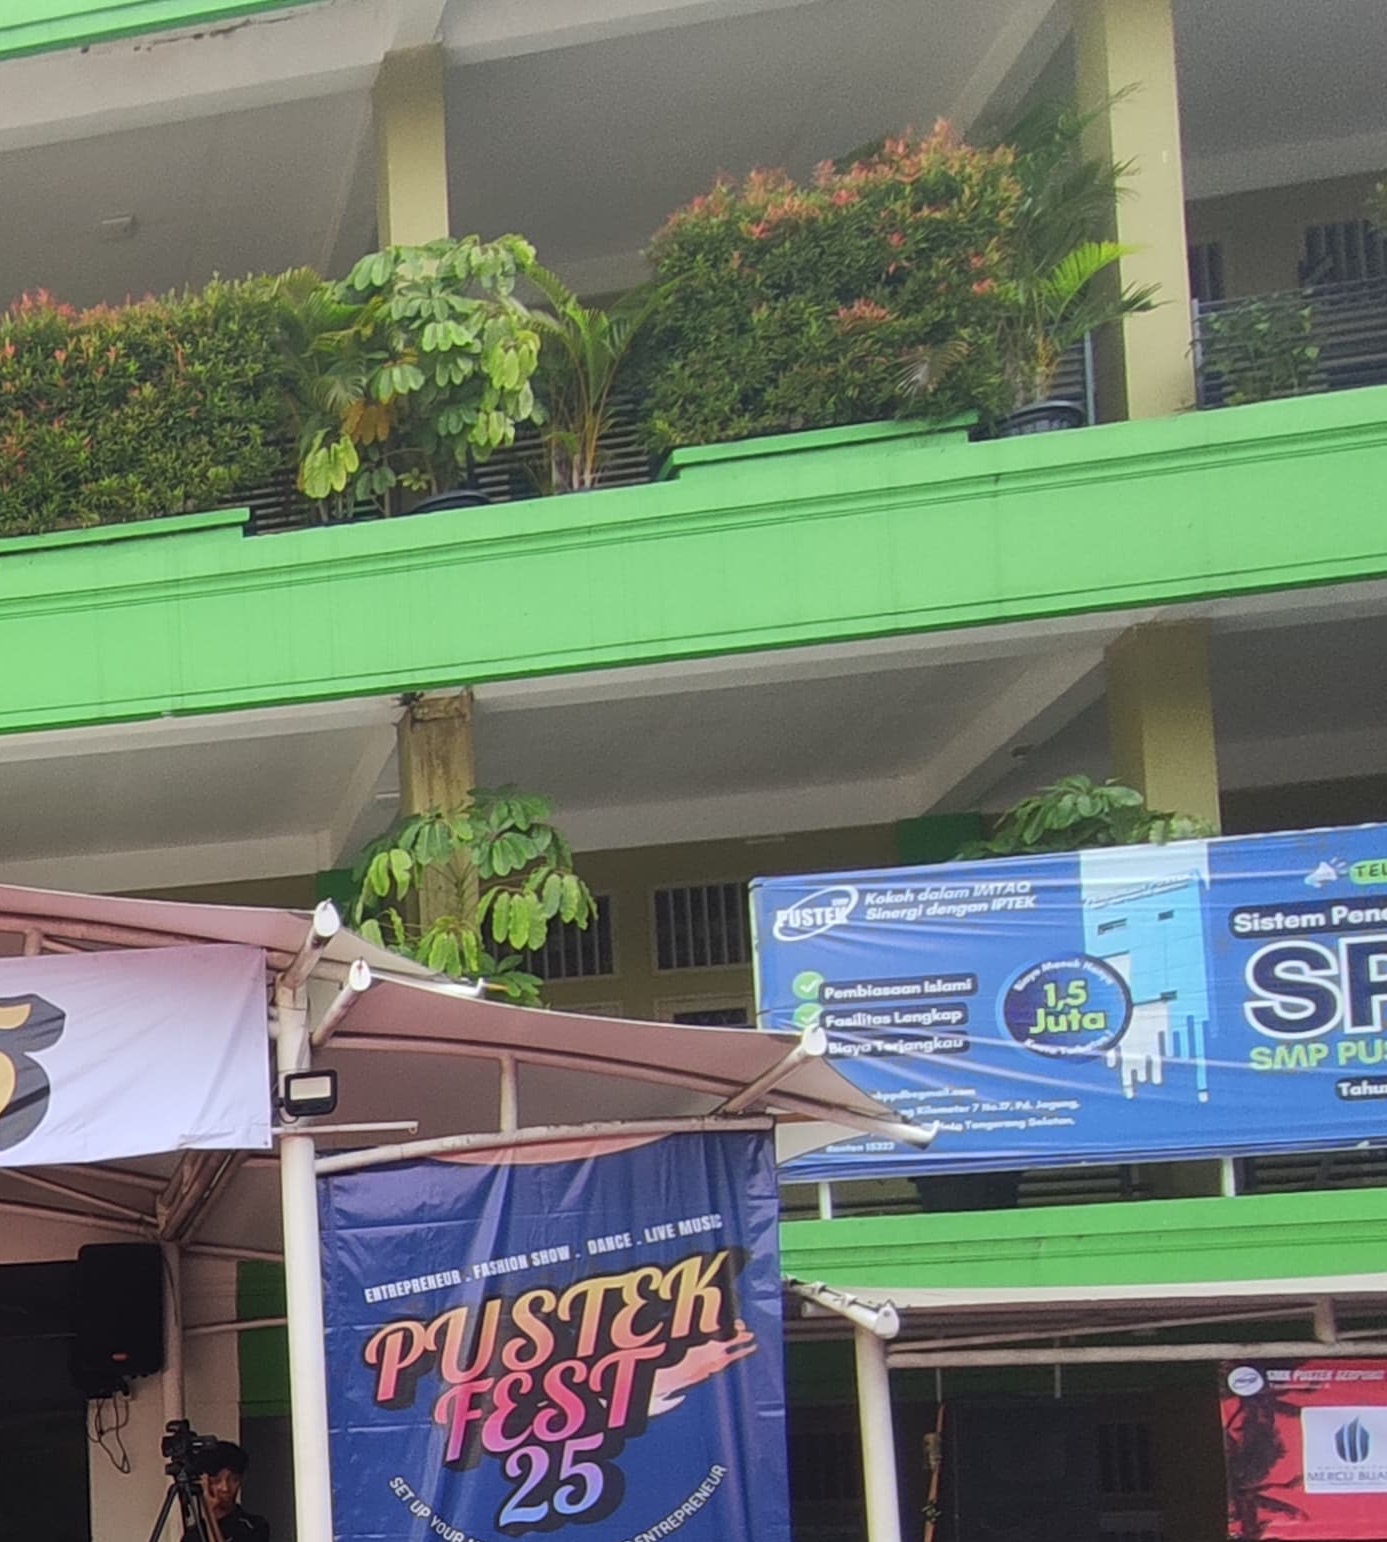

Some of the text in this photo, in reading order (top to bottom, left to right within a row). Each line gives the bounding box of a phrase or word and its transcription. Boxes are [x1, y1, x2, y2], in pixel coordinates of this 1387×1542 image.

[865, 890, 915, 907] Kokoh
[918, 887, 970, 902] dalam
[865, 895, 1037, 921] Sinergi dengan IPTEK
[777, 906, 848, 928] PUSTEK
[1234, 911, 1326, 933] Sistem
[824, 978, 972, 1000] Pembiasaan Islami
[1043, 979, 1087, 1012] 1,5
[825, 1008, 963, 1029] Fasilitas Lengkap
[1029, 1007, 1107, 1034] Juta
[829, 1039, 871, 1056] Biaya
[1249, 1038, 1387, 1070] SMP PU
[363, 1213, 723, 1304] ENTREPRENEUR FASHION SHOW DANCE LIVE MUSIC
[364, 1250, 731, 1403] PUSTEK
[433, 1342, 667, 1463] FEST
[498, 1431, 605, 1528] 25
[388, 1475, 415, 1503] SET
[409, 1497, 431, 1520] UP
